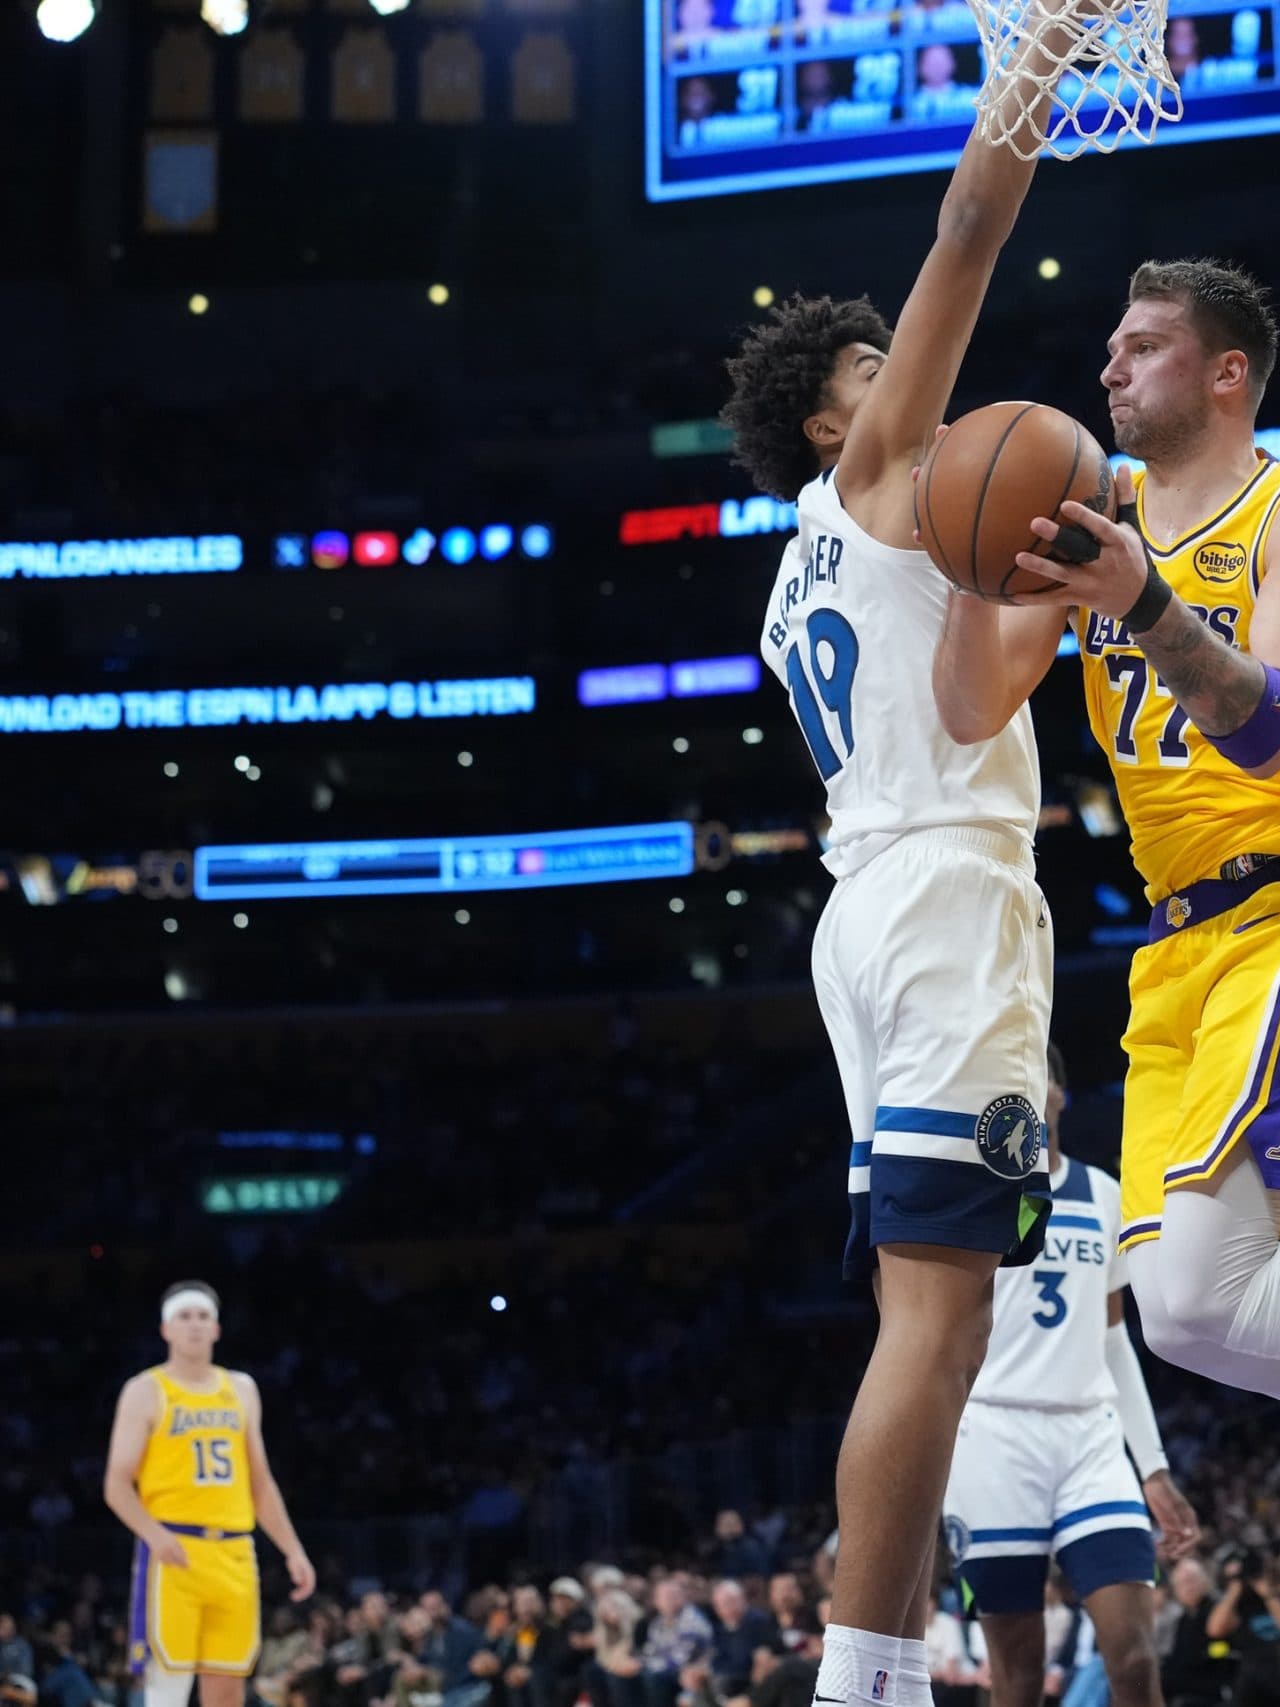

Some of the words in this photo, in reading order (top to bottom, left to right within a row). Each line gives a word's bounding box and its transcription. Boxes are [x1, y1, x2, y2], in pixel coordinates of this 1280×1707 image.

[1200, 551, 1244, 571] bibigo
[122, 691, 186, 728] THE
[188, 687, 276, 727] ESPN
[320, 682, 388, 720] APP
[417, 676, 535, 717] LISTEN
[786, 607, 860, 783] 19
[1104, 653, 1190, 768] 77
[979, 1097, 1014, 1145] MINNESOTA
[1017, 1097, 1040, 1167] TIMBERWOLVES
[1032, 1270, 1067, 1329] 3
[169, 1405, 241, 1436] LAKERS
[192, 1439, 236, 1486] 15
